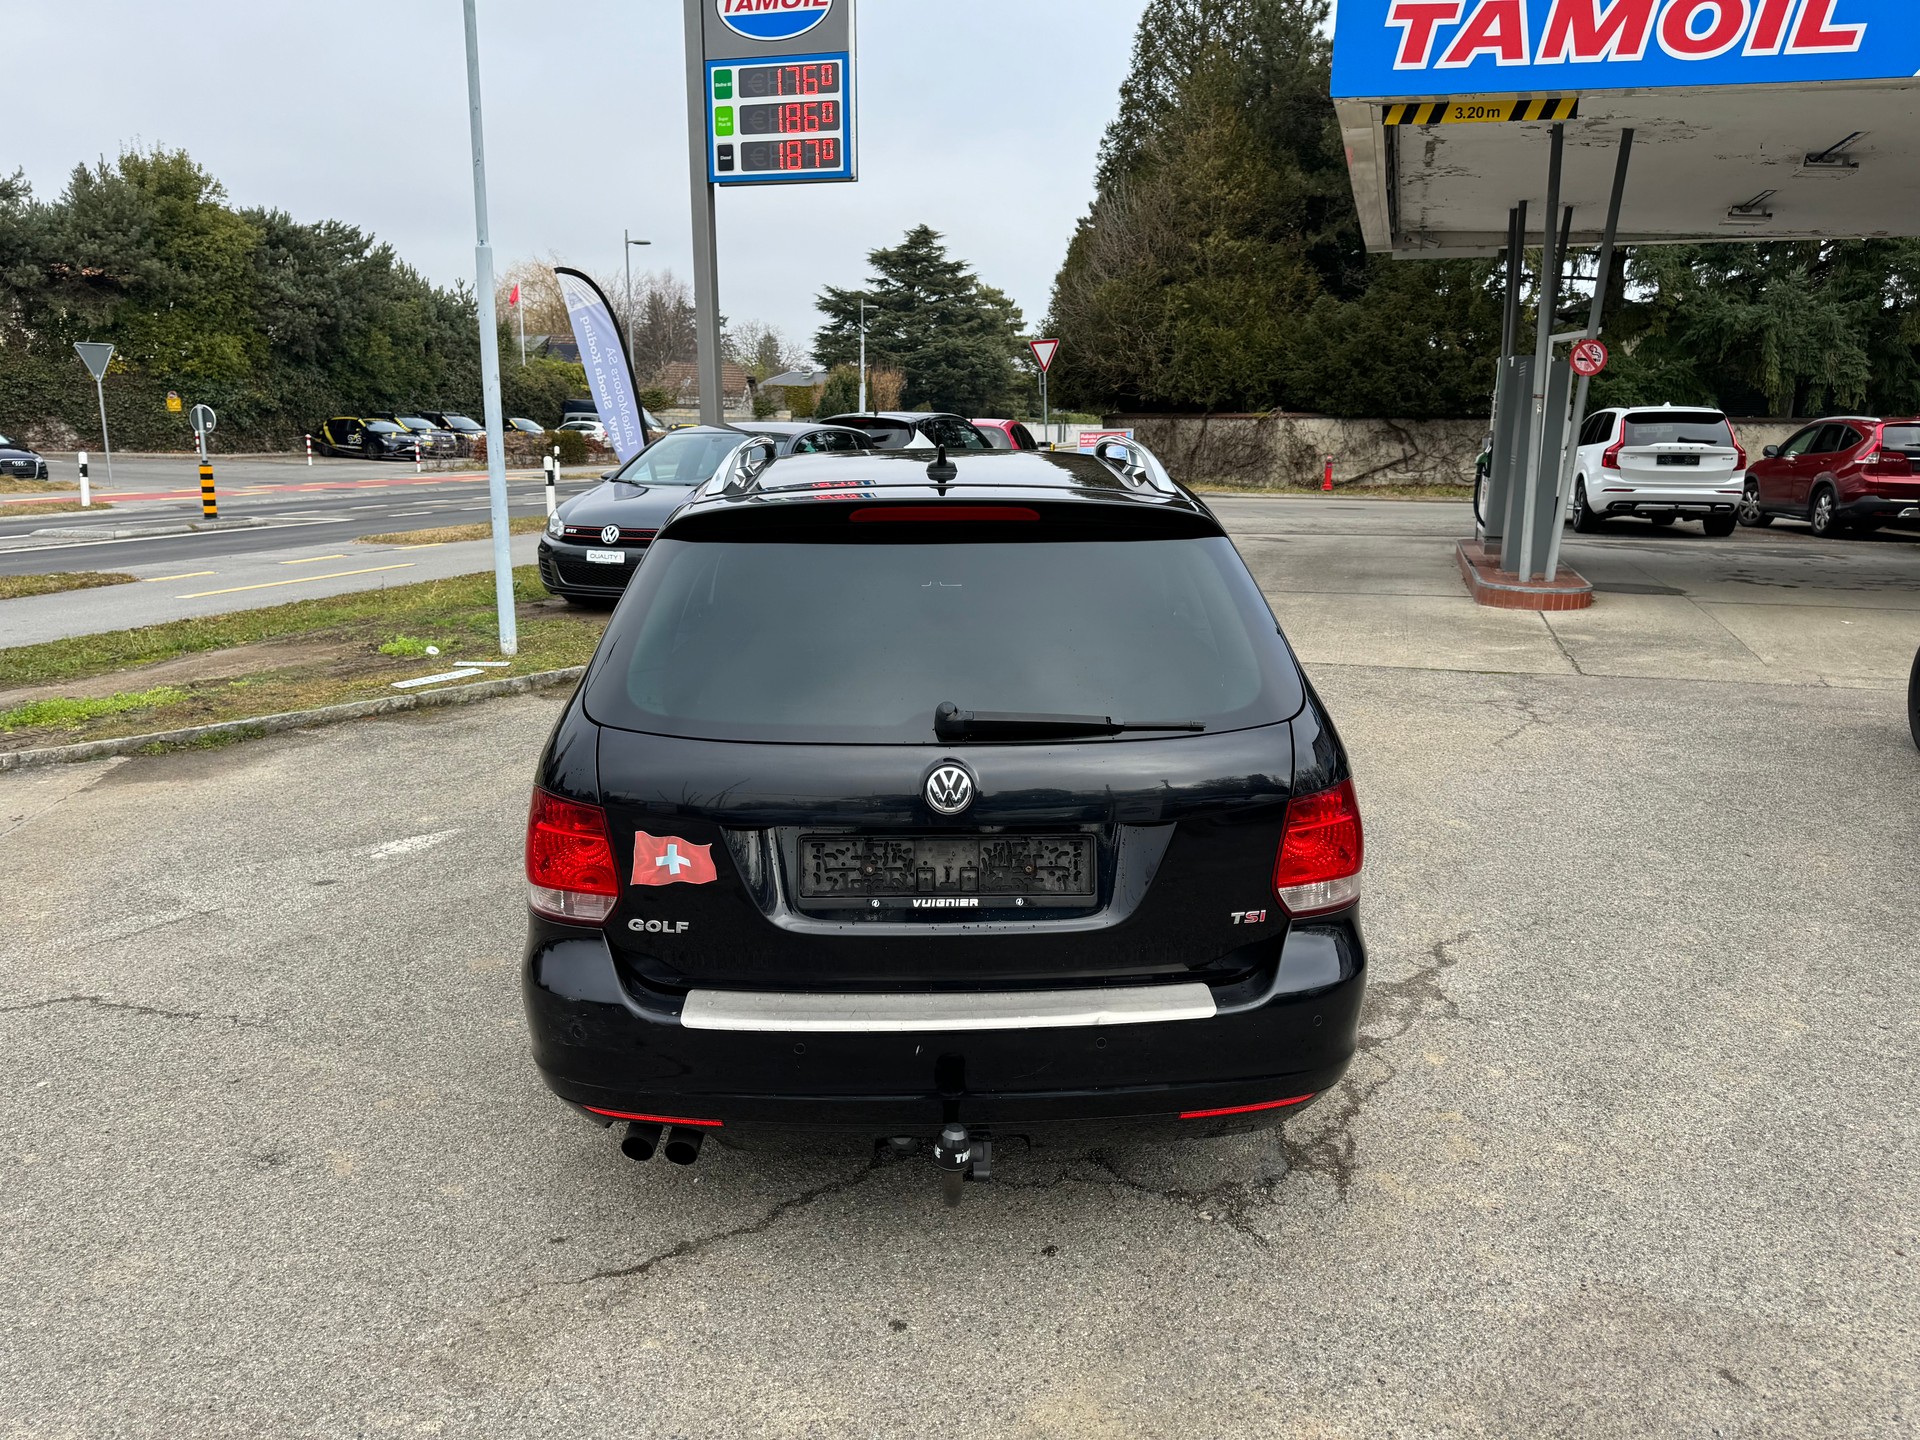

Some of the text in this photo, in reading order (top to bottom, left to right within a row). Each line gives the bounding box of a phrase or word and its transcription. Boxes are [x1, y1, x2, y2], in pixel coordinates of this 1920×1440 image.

[1385, 0, 1868, 70] TAMOIL
[777, 64, 833, 96] 1760
[778, 101, 833, 133] 1860
[1455, 106, 1501, 119] 3.20 m
[779, 139, 834, 170] 1870
[913, 898, 979, 907] VUIGNIER
[628, 918, 690, 934] GOLF
[1231, 909, 1267, 924] TSI
